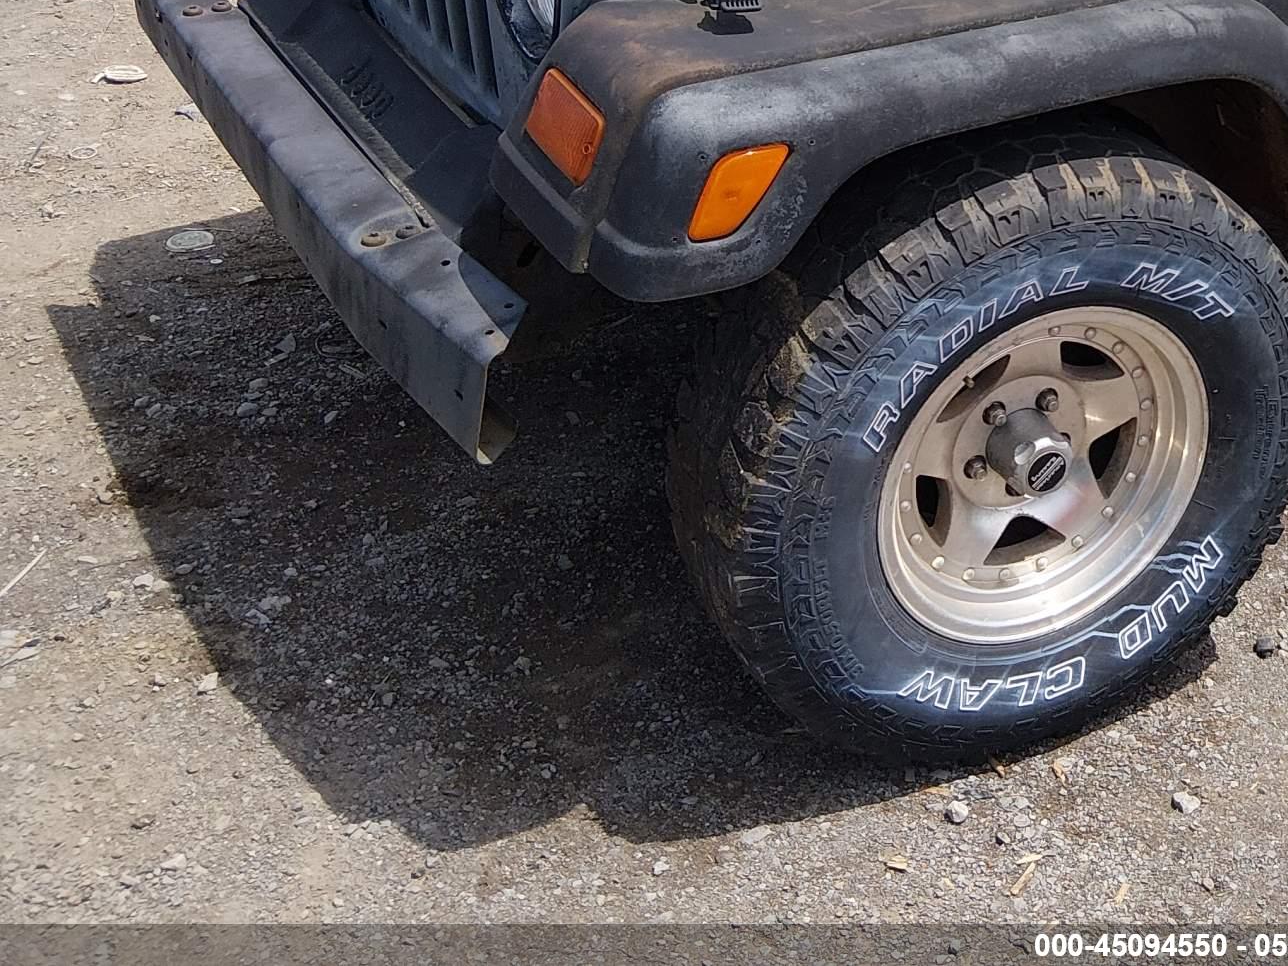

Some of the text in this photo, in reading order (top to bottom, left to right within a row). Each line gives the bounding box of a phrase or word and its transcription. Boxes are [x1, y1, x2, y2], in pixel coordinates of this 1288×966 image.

[860, 261, 1238, 454] RADIAL M/T
[1115, 534, 1224, 662] MUD
[897, 654, 1088, 714] CLAW
